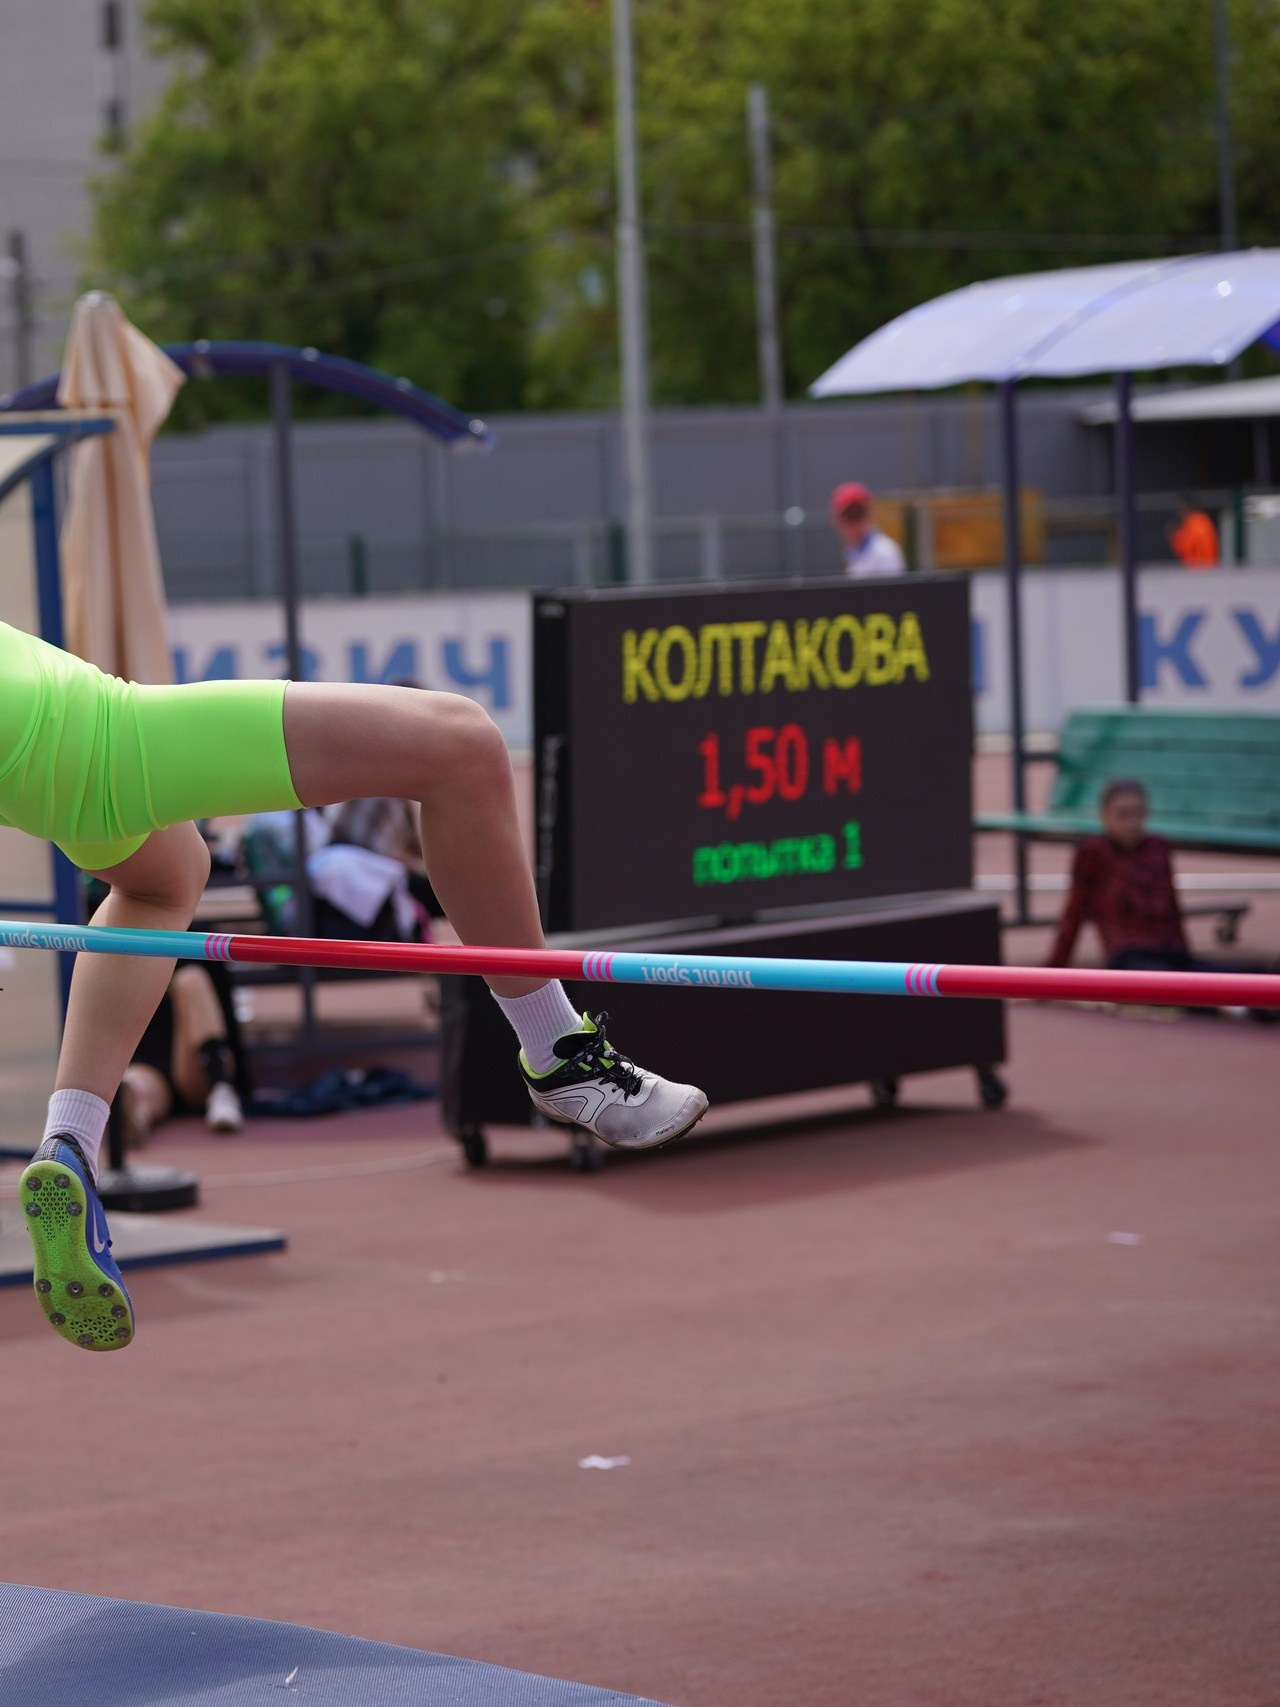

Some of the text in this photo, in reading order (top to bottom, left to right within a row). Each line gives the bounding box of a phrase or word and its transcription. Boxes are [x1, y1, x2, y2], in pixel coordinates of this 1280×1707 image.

[622, 612, 930, 703] КОЛТАКОВА
[698, 723, 809, 820] 1,50
[693, 819, 864, 887] попытка 1
